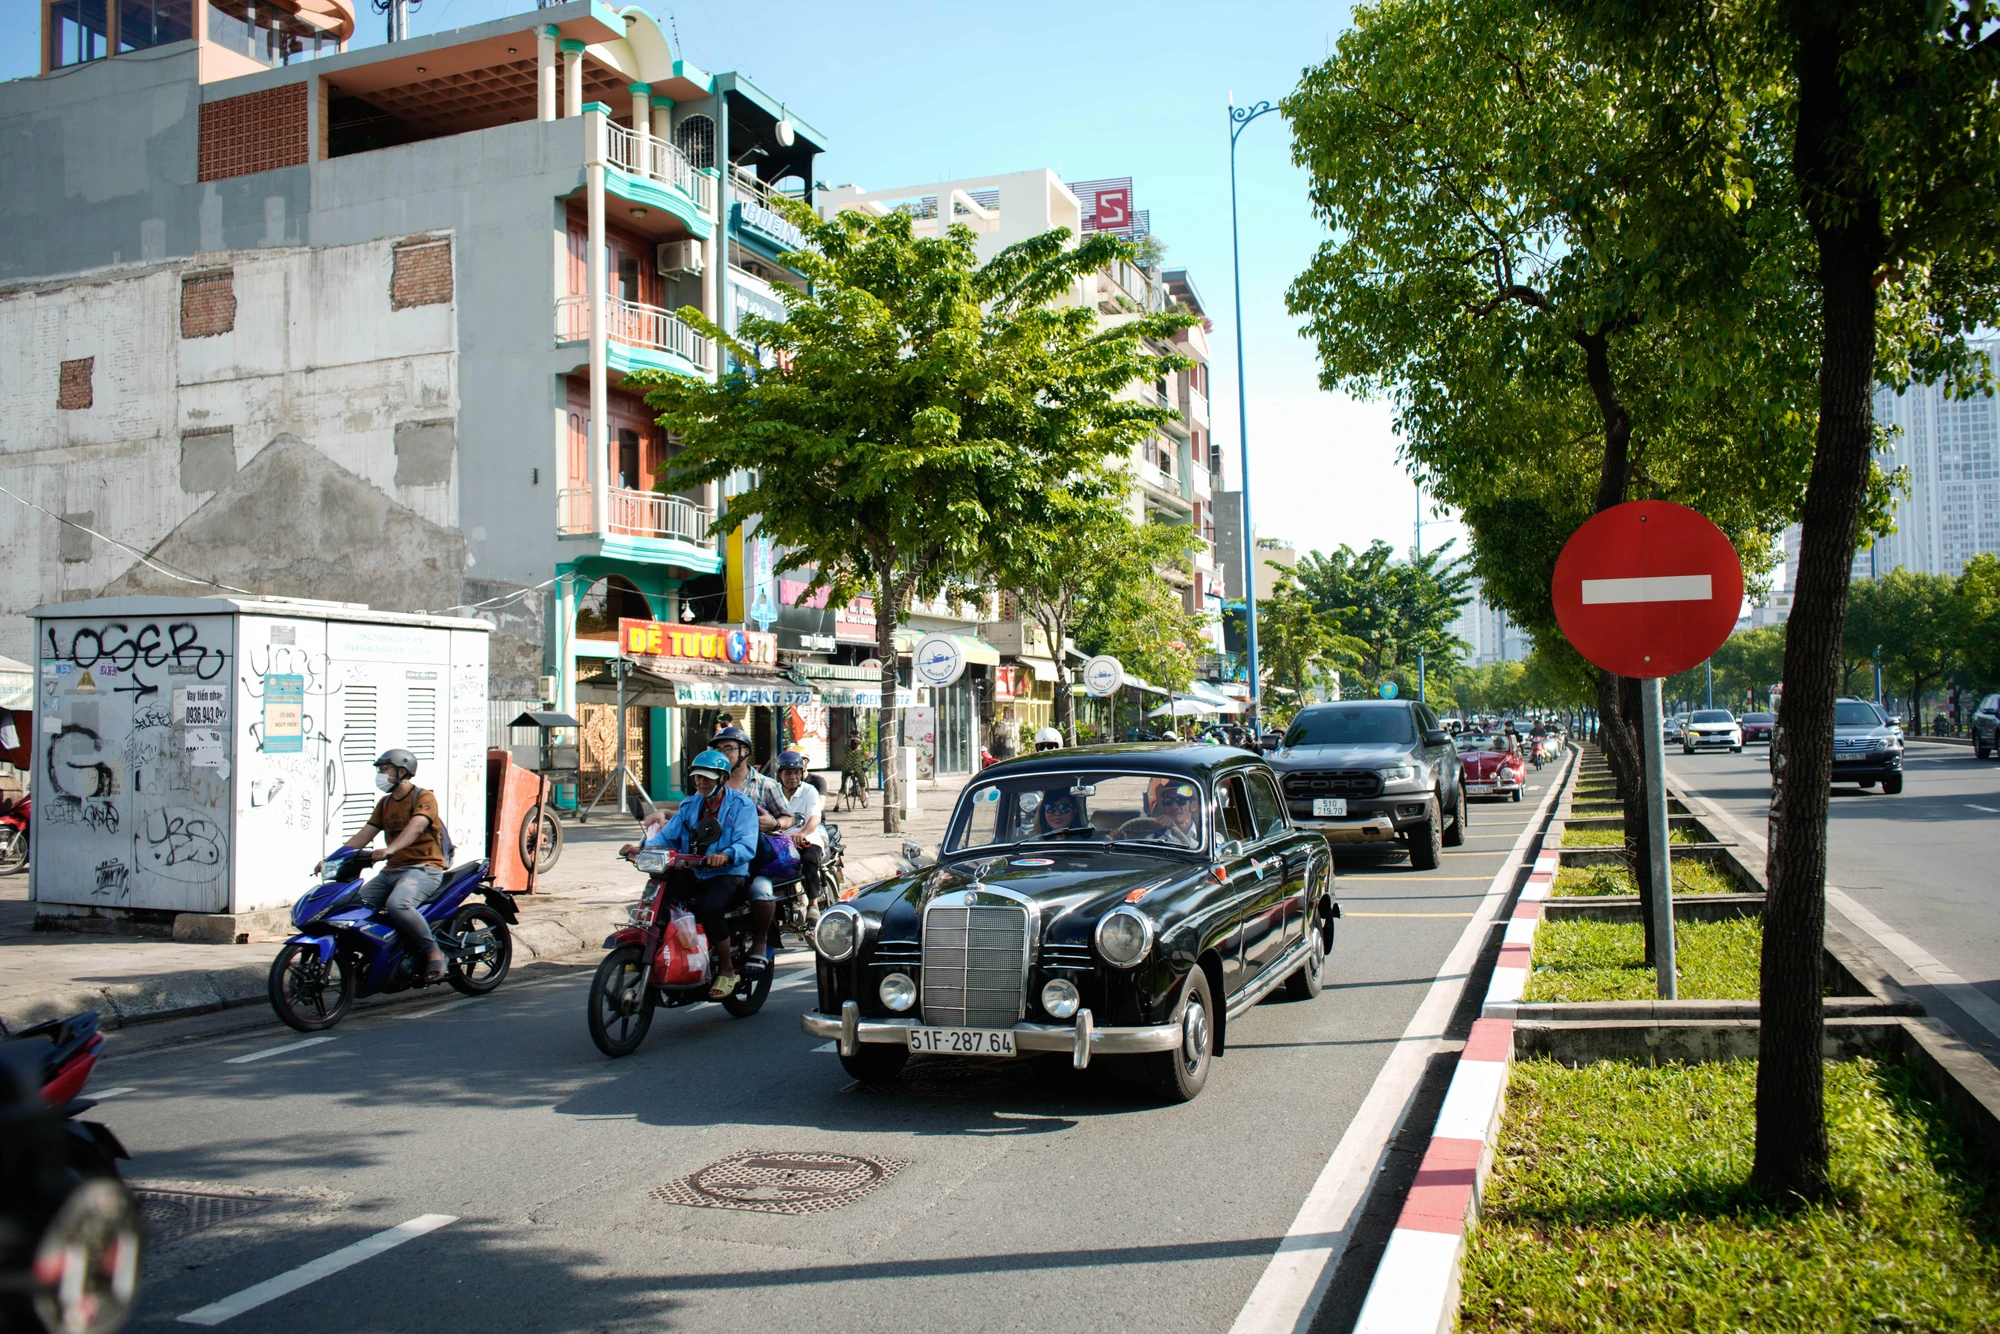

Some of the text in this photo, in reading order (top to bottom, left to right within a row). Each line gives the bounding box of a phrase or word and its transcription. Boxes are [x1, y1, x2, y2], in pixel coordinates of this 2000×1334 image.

[742, 200, 806, 249] BOEING
[748, 633, 775, 662] 378
[926, 668, 945, 677] Boeing
[186, 690, 196, 702] Vay
[728, 689, 781, 704] BOEING
[1286, 780, 1378, 789] FORD
[1317, 807, 1343, 815] 719.70
[910, 1030, 1013, 1053] 51F-287.64
